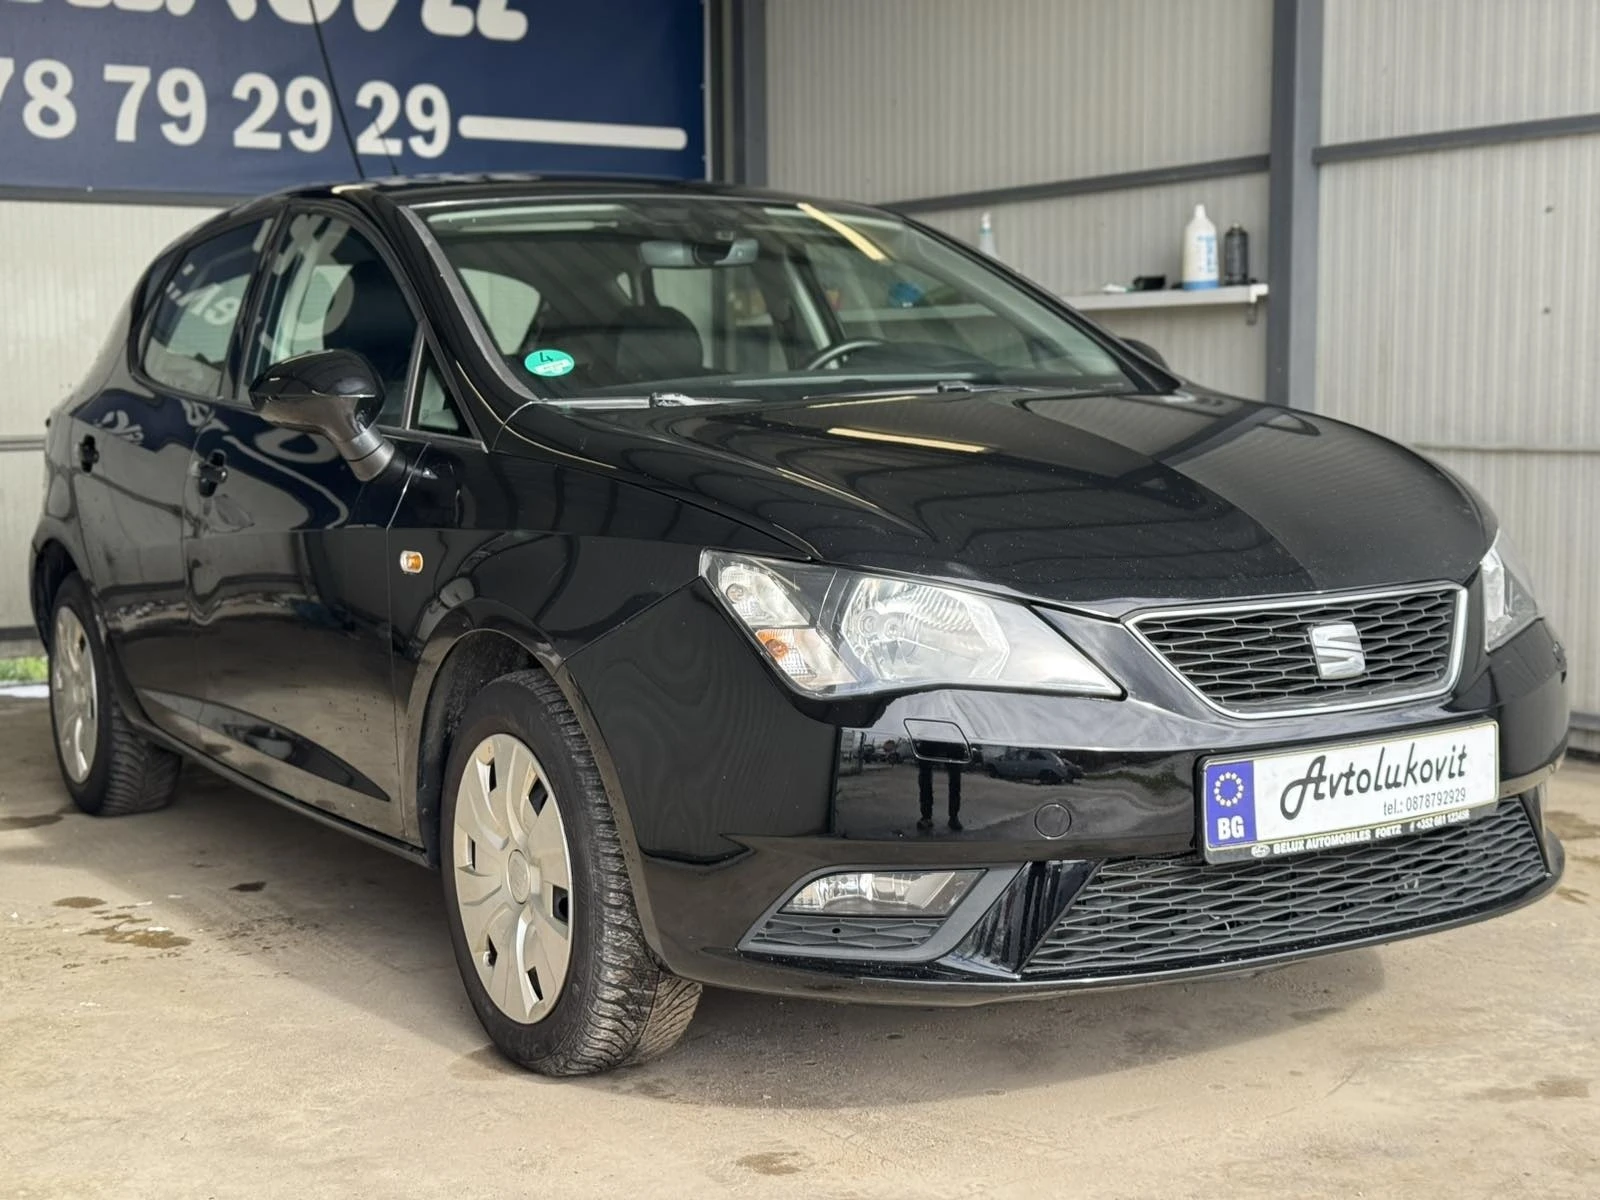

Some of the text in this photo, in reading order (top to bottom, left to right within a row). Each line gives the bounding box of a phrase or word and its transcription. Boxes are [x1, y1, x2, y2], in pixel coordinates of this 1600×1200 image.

[103, 63, 207, 146] 79
[231, 72, 333, 153] 29
[355, 80, 451, 159] 29
[1280, 742, 1467, 820] Avtolukovit
[1405, 787, 1466, 812] 0878792929
[1217, 815, 1245, 841] BG
[1273, 840, 1305, 854] BELUX
[1306, 829, 1371, 849] AUTOMOBILES
